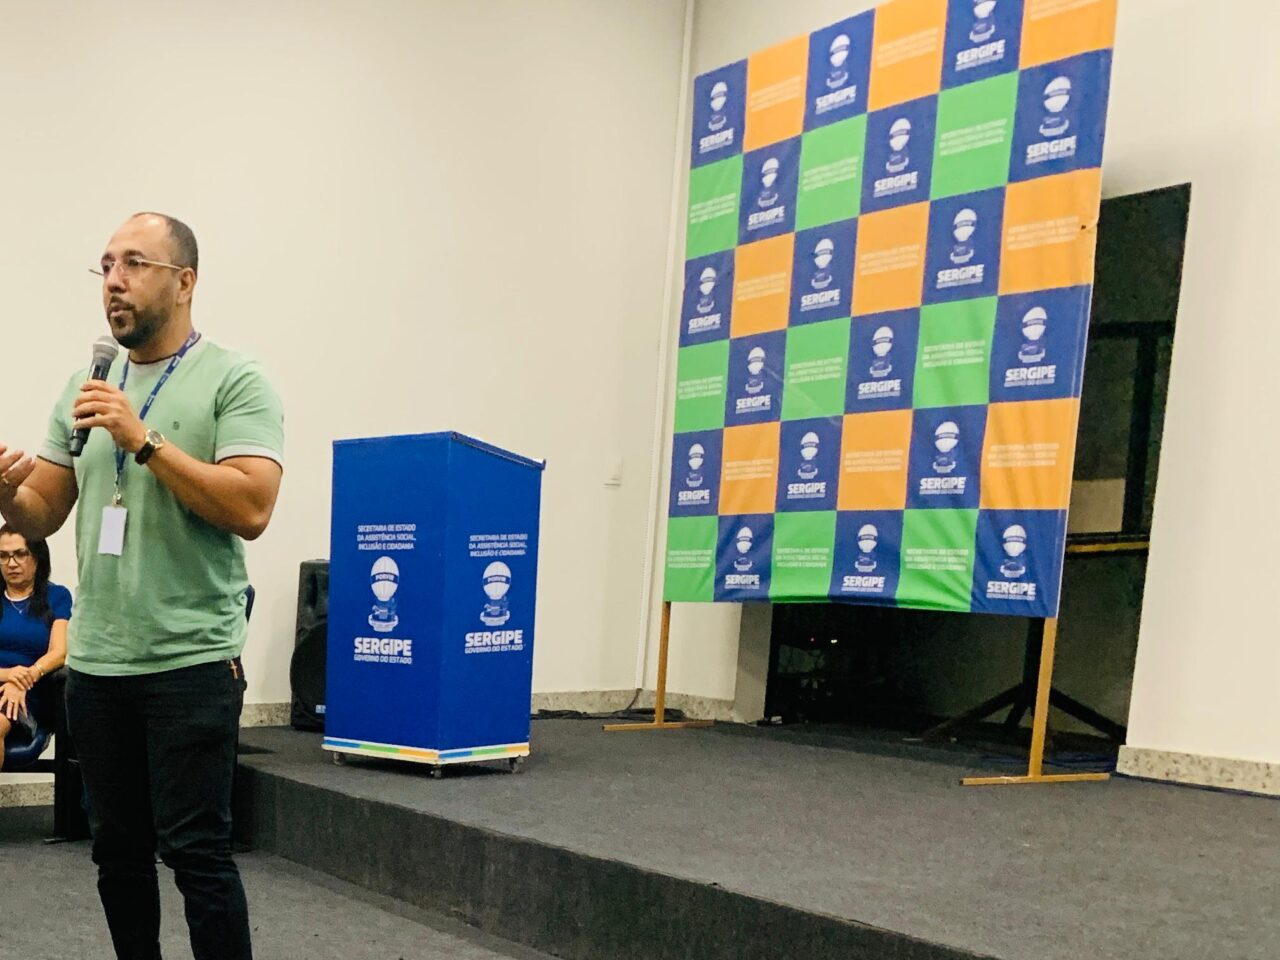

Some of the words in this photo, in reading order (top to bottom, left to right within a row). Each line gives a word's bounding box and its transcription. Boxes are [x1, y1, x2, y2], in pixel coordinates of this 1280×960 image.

[956, 39, 1005, 65] SERGIPE
[816, 86, 856, 109] SERGIPE
[700, 128, 734, 149] SERGIPE
[1027, 136, 1076, 158] SERGIPE
[874, 171, 917, 192] SERGIPE
[748, 206, 785, 225] SERGIPE
[937, 264, 984, 283] SERGIPE
[801, 289, 840, 306] SERGIPE
[688, 313, 721, 330] SERGIPE
[1005, 366, 1055, 381] SERGIPE
[858, 380, 900, 395] SERGIPE
[736, 395, 770, 409] SERGIPE
[788, 482, 825, 495] SERGIPE
[920, 477, 966, 490] SERGIPE
[678, 490, 709, 502] SERGIPE
[725, 575, 759, 586] SERGIPE
[844, 577, 884, 588] SERGIPE
[987, 582, 1036, 596] SERGIPE
[354, 637, 412, 656] SERGIPE
[465, 630, 523, 647] SERGIPE
[380, 655, 388, 663] DO
[389, 656, 412, 664] ESTADO
